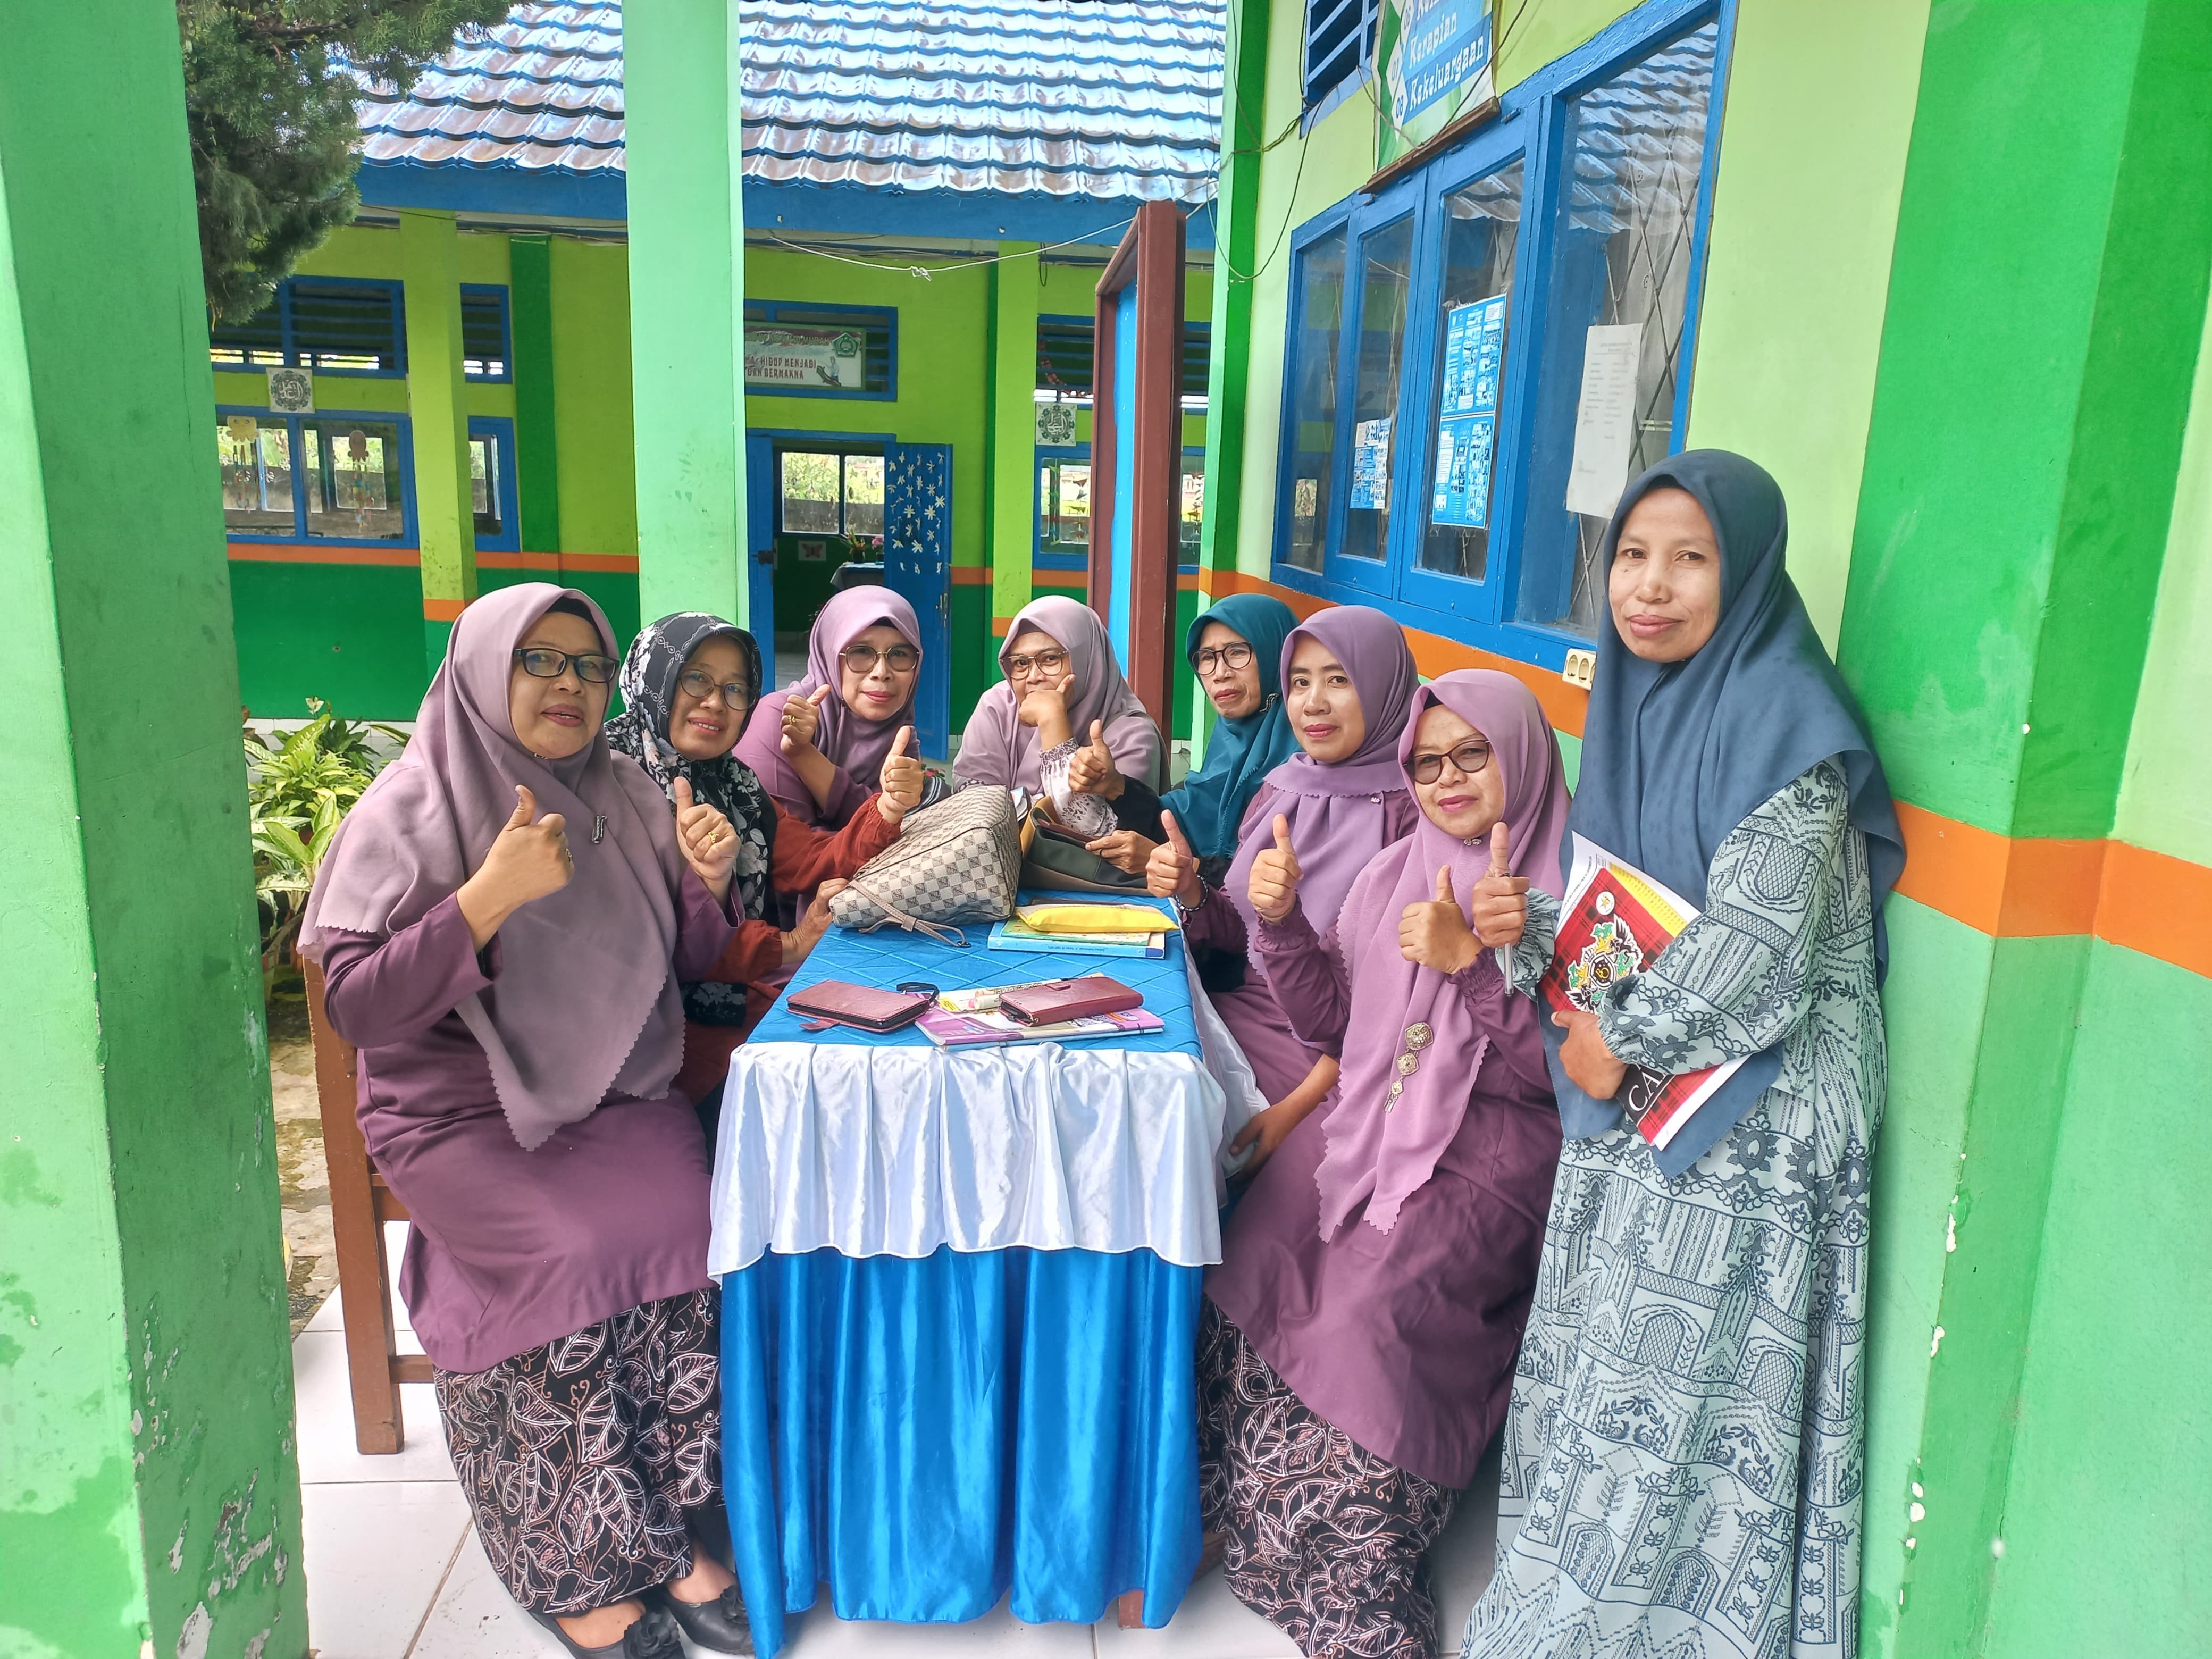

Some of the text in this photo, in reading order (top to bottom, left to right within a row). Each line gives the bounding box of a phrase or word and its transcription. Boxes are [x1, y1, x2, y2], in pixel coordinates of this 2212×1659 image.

[1409, 12, 1457, 69] Kerapian
[1396, 36, 1484, 119] 08 Kekeluargaan
[747, 368, 804, 379] DAN BERMAKNA
[760, 357, 783, 366] HIDUP
[784, 358, 816, 368] MENJADI
